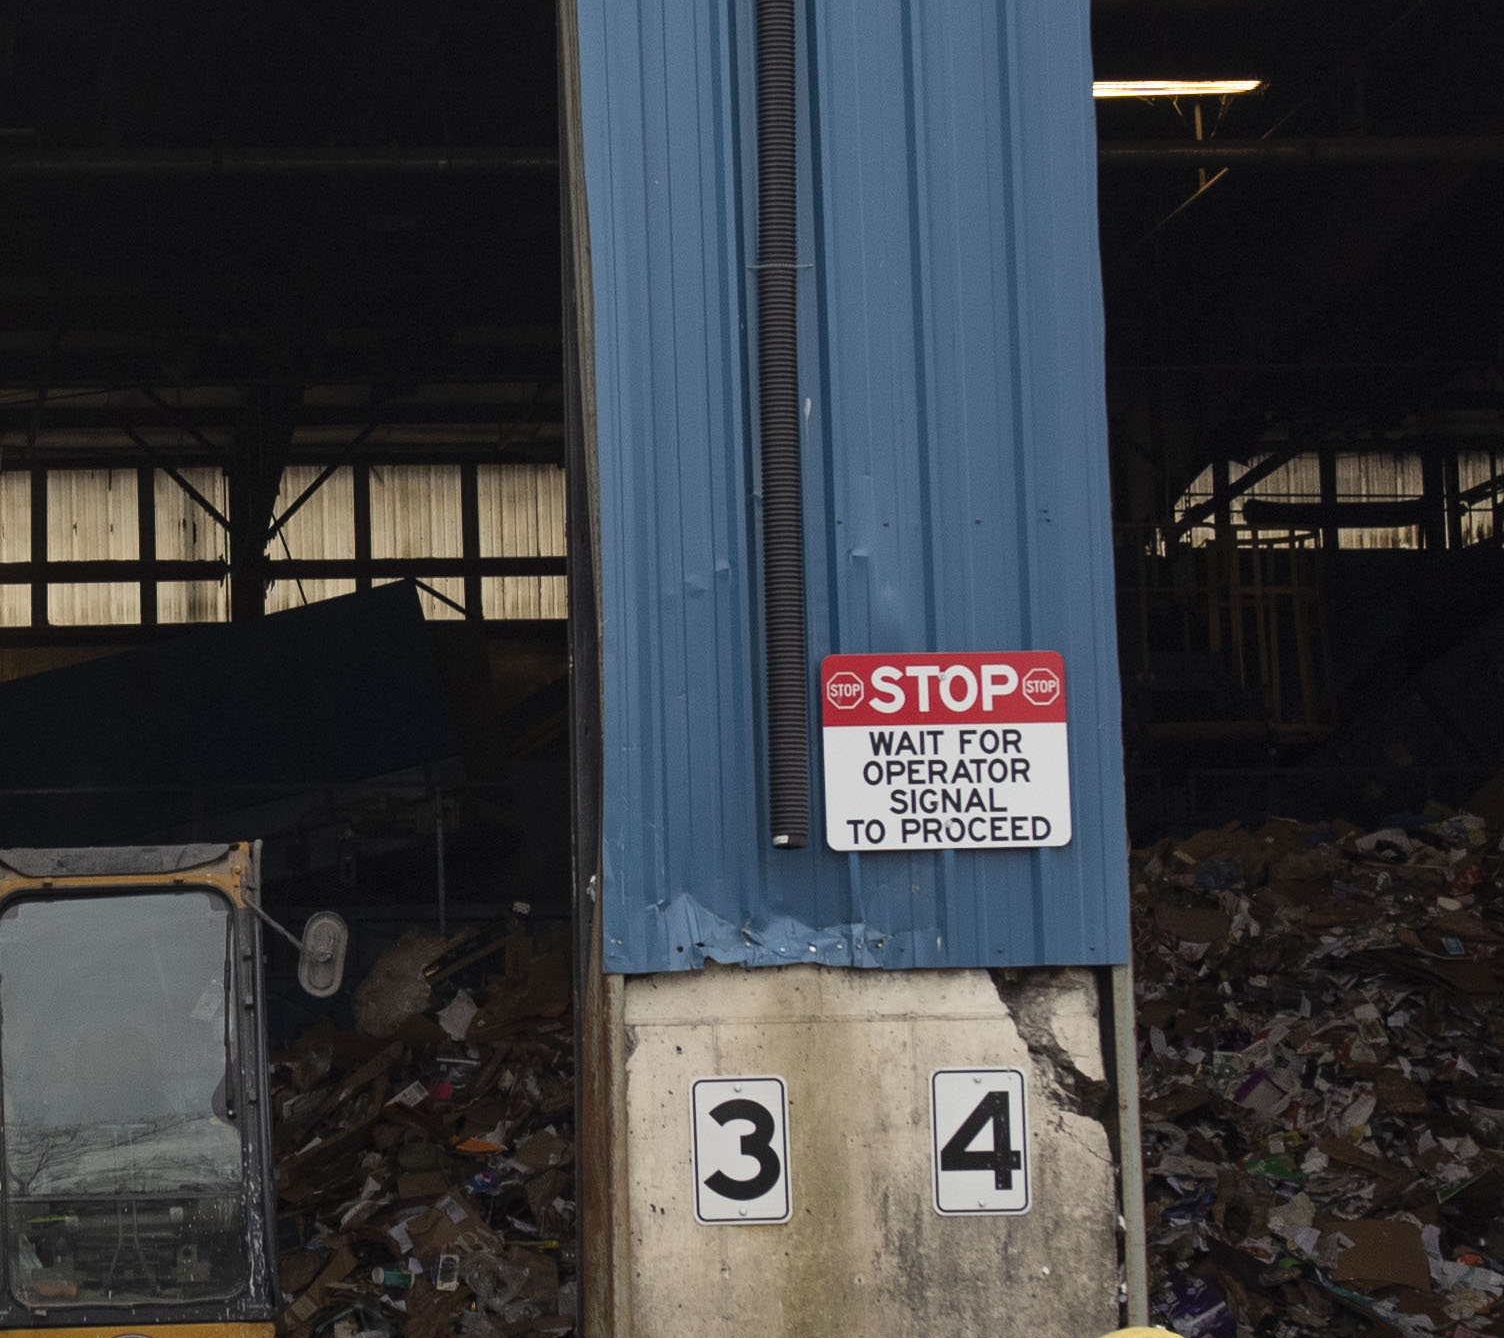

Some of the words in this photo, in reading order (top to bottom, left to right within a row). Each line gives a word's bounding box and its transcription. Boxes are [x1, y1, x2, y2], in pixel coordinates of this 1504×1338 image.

[830, 682, 860, 697] STOP
[868, 664, 1019, 714] STOP
[1025, 679, 1057, 694] STOP
[869, 730, 944, 756] WAIT
[959, 729, 1022, 755] FOR
[863, 758, 1031, 786] OPERATOR
[889, 788, 1008, 815] SIGNAL
[846, 818, 886, 844] TO
[901, 816, 1051, 843] PROCEED
[703, 1098, 781, 1201] 3
[941, 1091, 1022, 1190] 4
